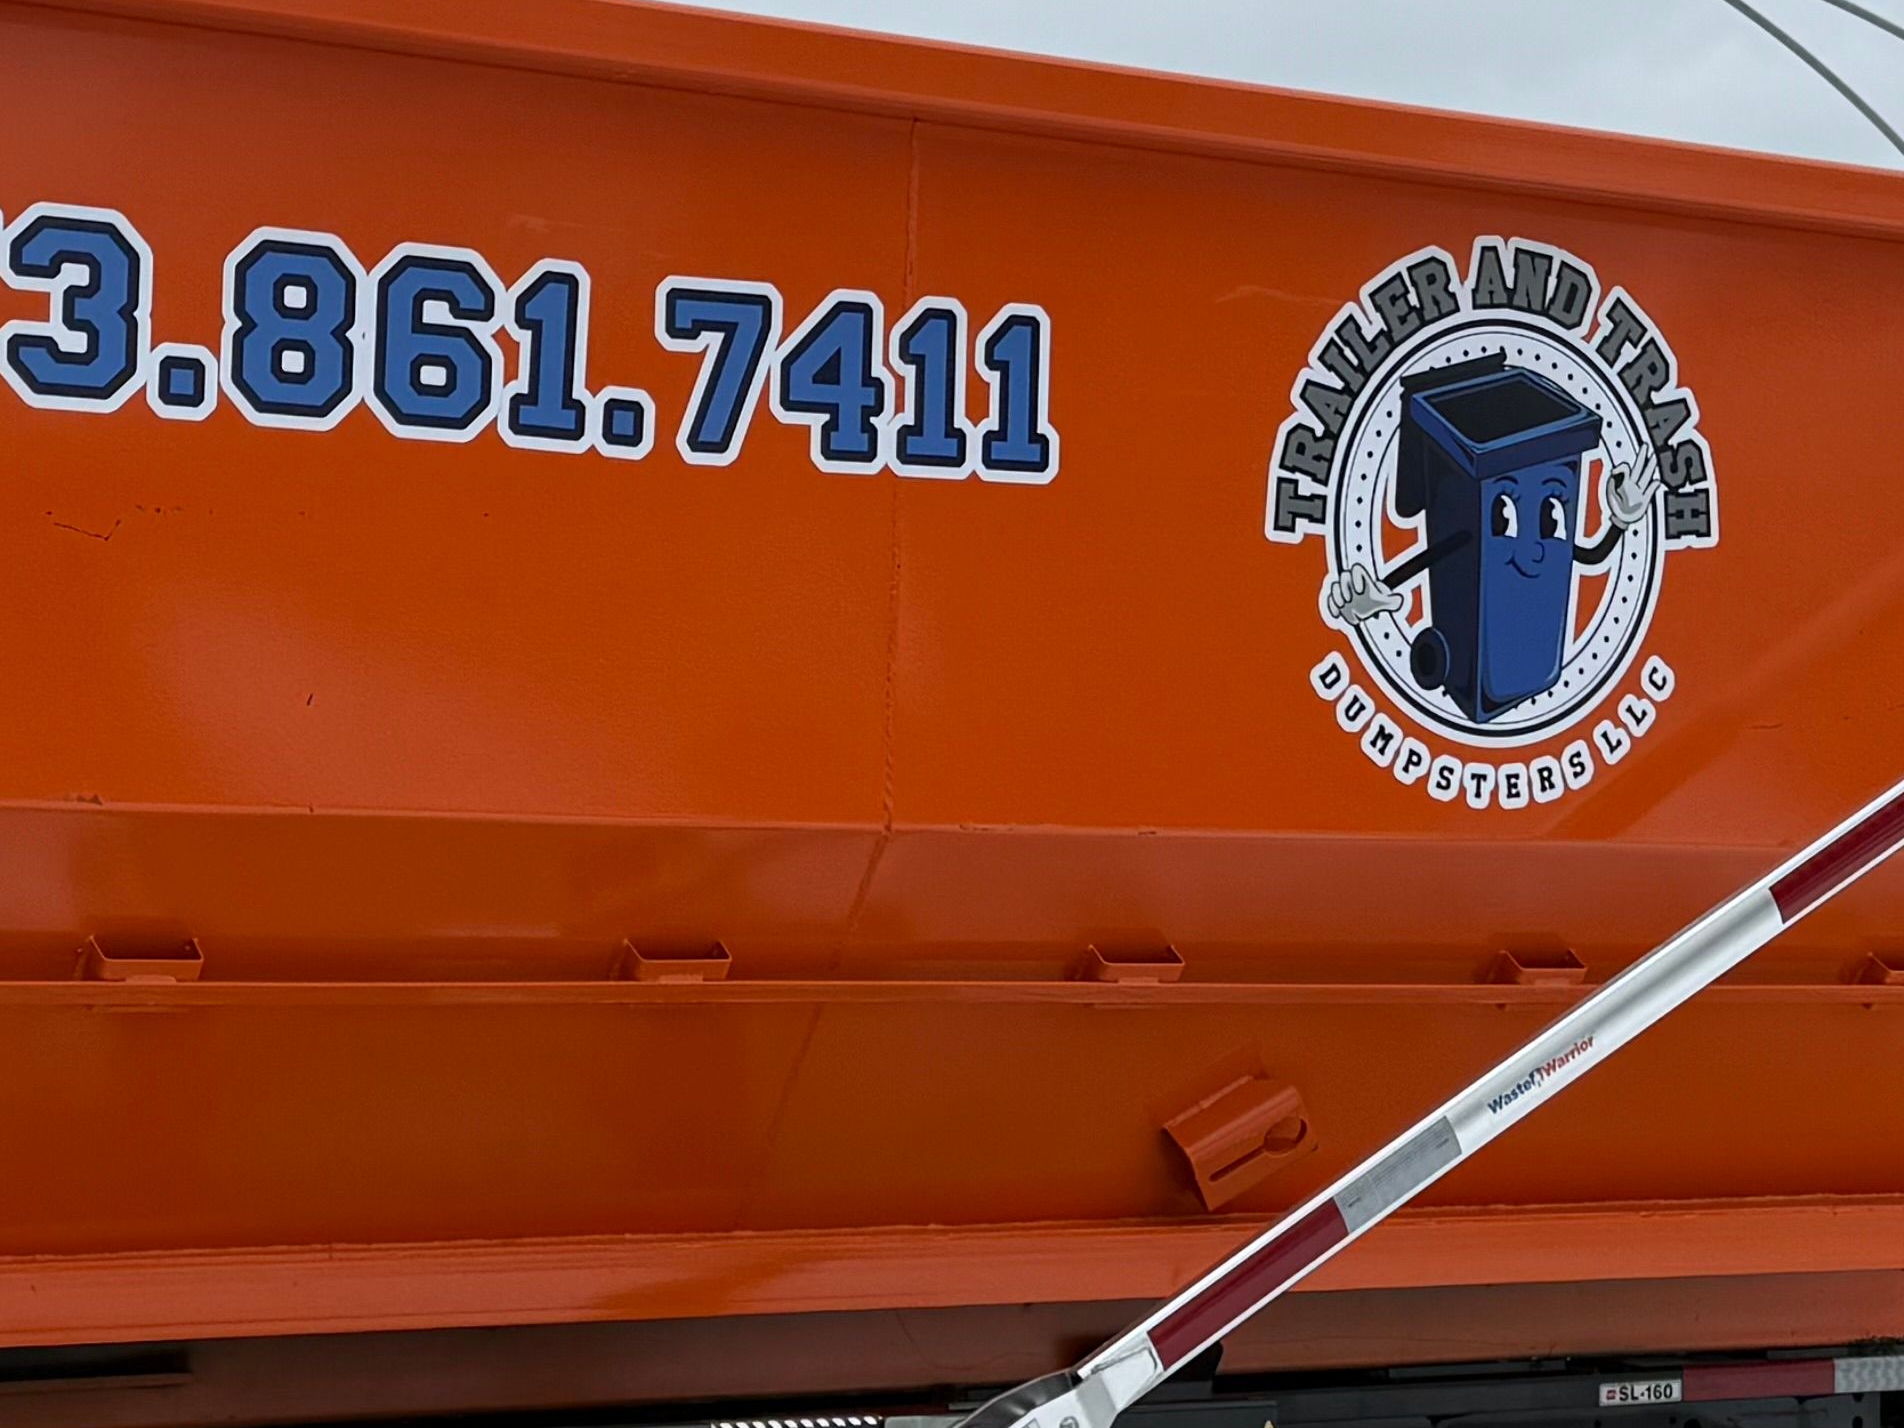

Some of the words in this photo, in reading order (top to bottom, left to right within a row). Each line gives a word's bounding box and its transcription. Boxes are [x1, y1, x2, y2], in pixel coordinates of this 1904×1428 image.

[1273, 253, 1460, 533] TRAILER
[1471, 245, 1593, 329] AND
[1597, 295, 1712, 543] TRASH
[1317, 661, 1589, 800] DUMPSTERS
[1600, 664, 1670, 752] LLC
[1543, 1035, 1596, 1079] Warrior
[1619, 1382, 1673, 1402] SL-160
